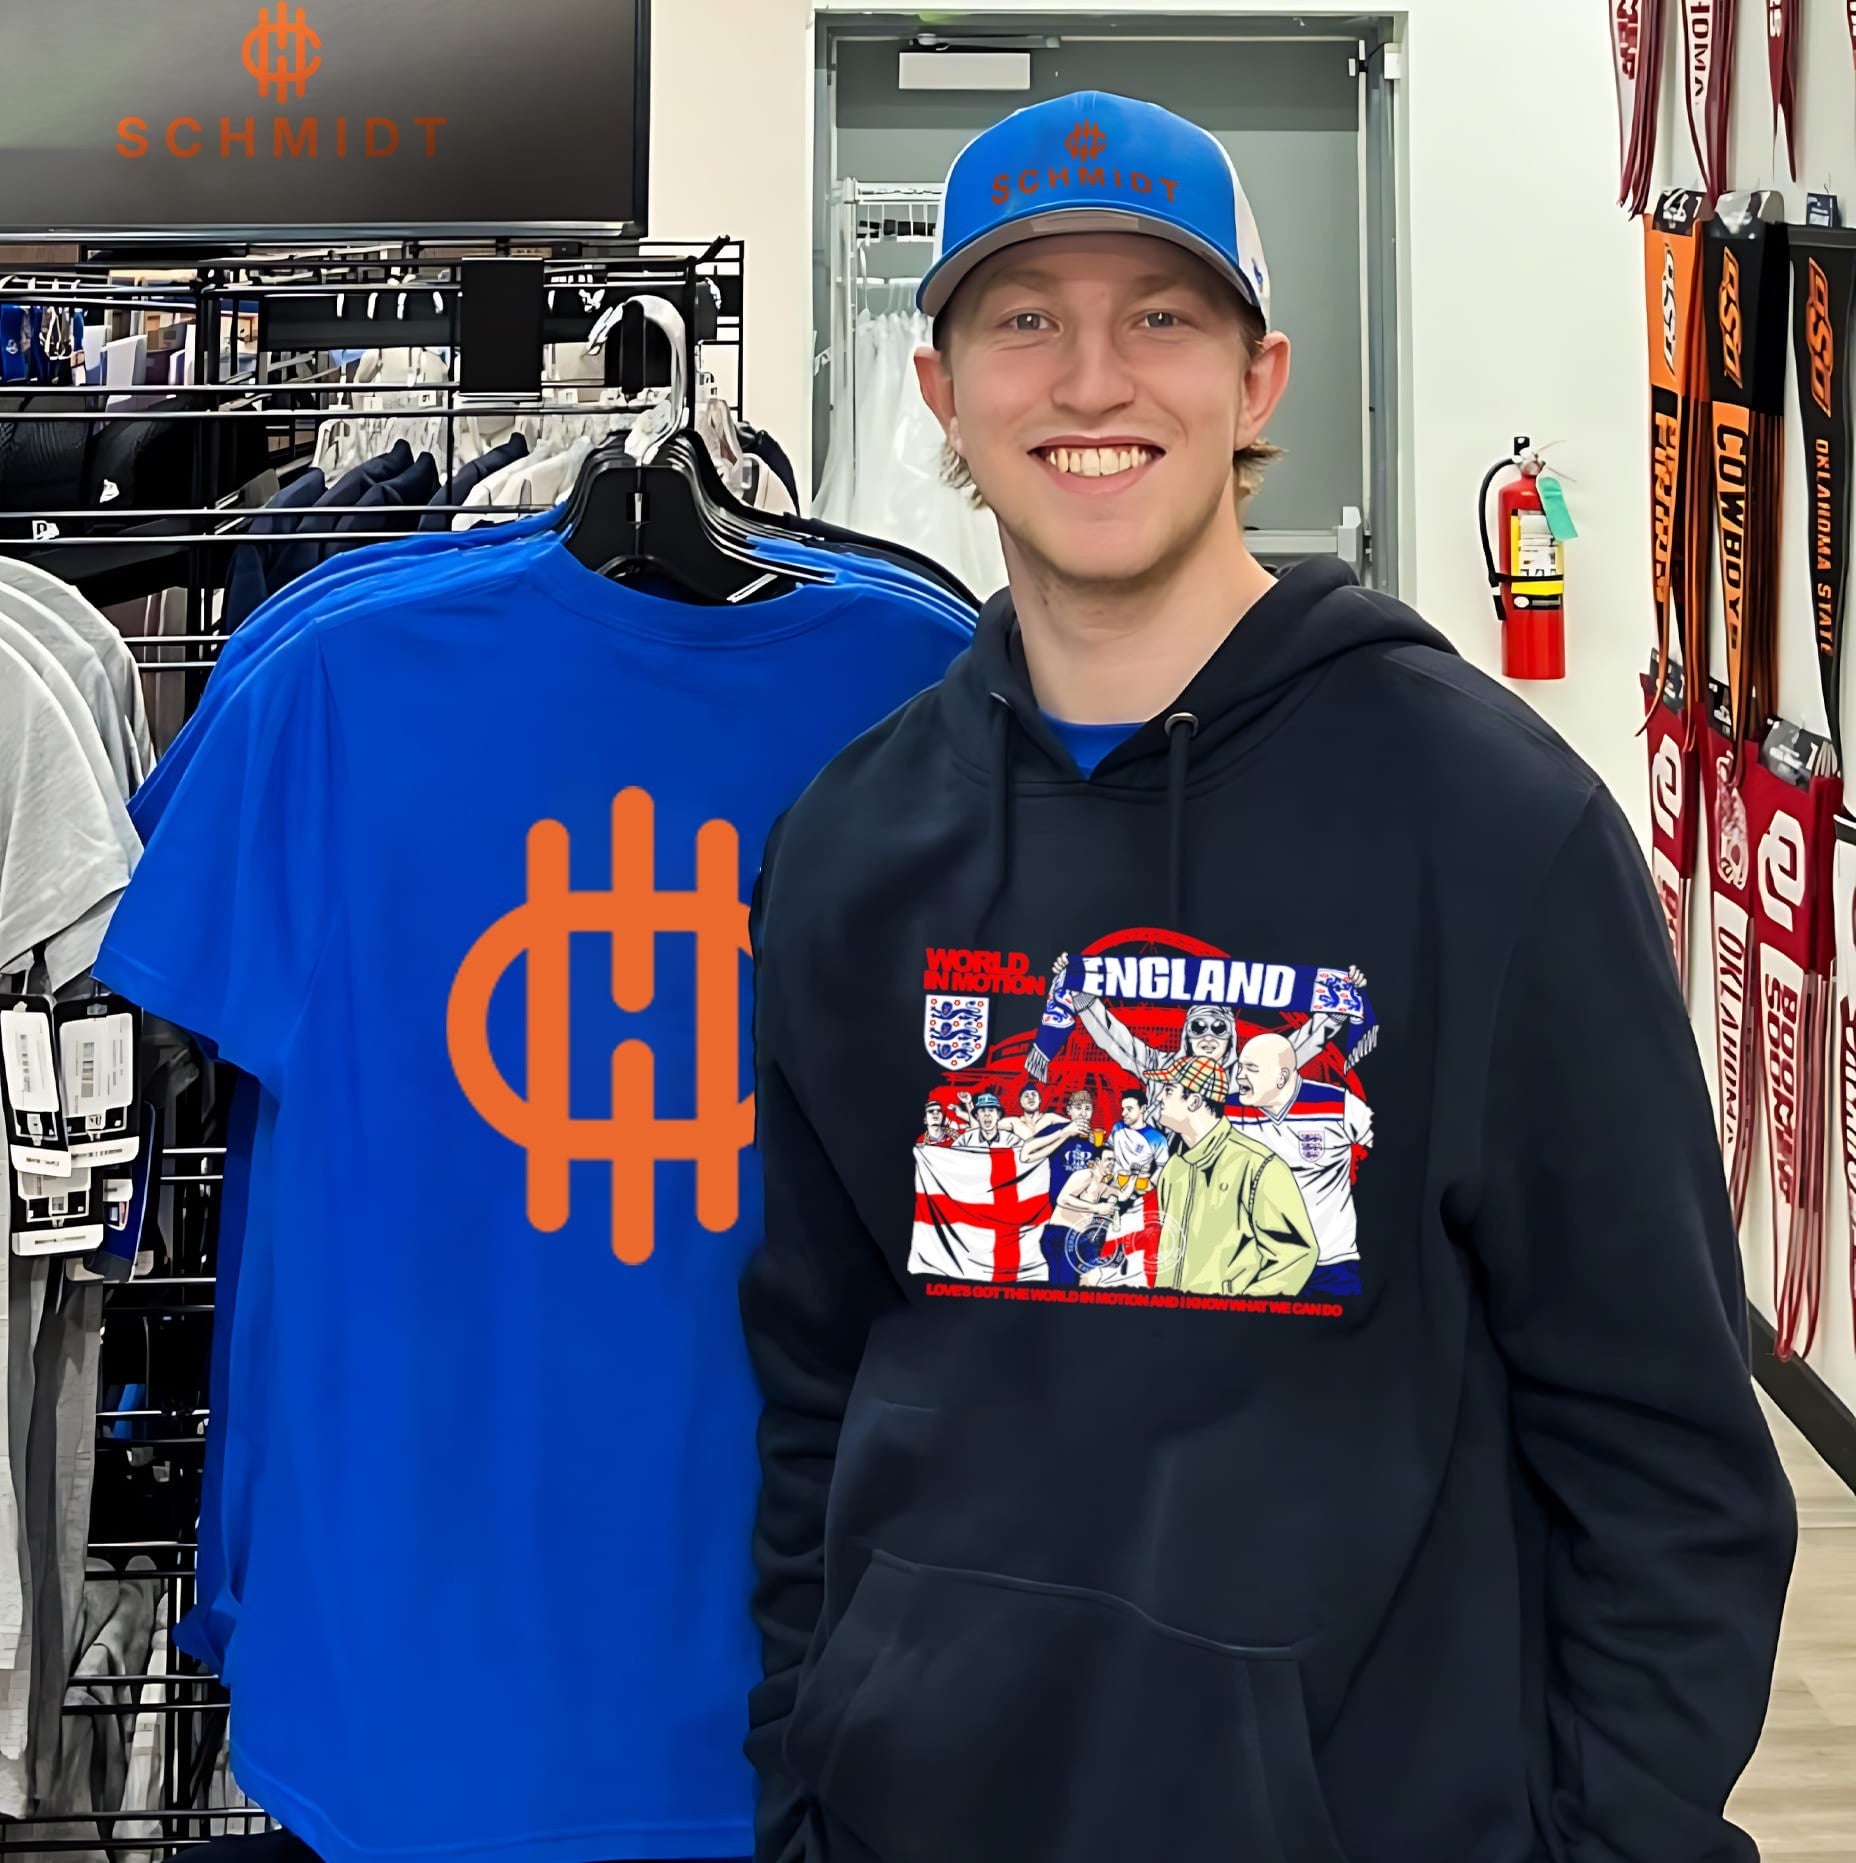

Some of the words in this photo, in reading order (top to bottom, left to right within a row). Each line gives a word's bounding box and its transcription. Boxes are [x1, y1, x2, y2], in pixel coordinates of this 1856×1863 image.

[117, 116, 447, 159] SCHMIDT
[991, 166, 1179, 205] SCHMIDT
[926, 947, 1030, 976] WORLD
[923, 970, 949, 991] IN
[951, 971, 1046, 996] MOTION
[1082, 956, 1296, 1008] ENGLAND
[972, 1285, 1001, 1299] GOT
[1001, 1287, 1029, 1300] THE
[1029, 1288, 1079, 1303] WORLD
[1079, 1290, 1095, 1304] IN
[1096, 1291, 1149, 1307] MOTION
[1152, 1295, 1179, 1308] AND
[1186, 1297, 1229, 1311] KNOW
[1229, 1299, 1269, 1313] WHAT
[1269, 1301, 1292, 1314] WE
[1292, 1303, 1321, 1316] CAN
[1322, 1304, 1343, 1318] DO
